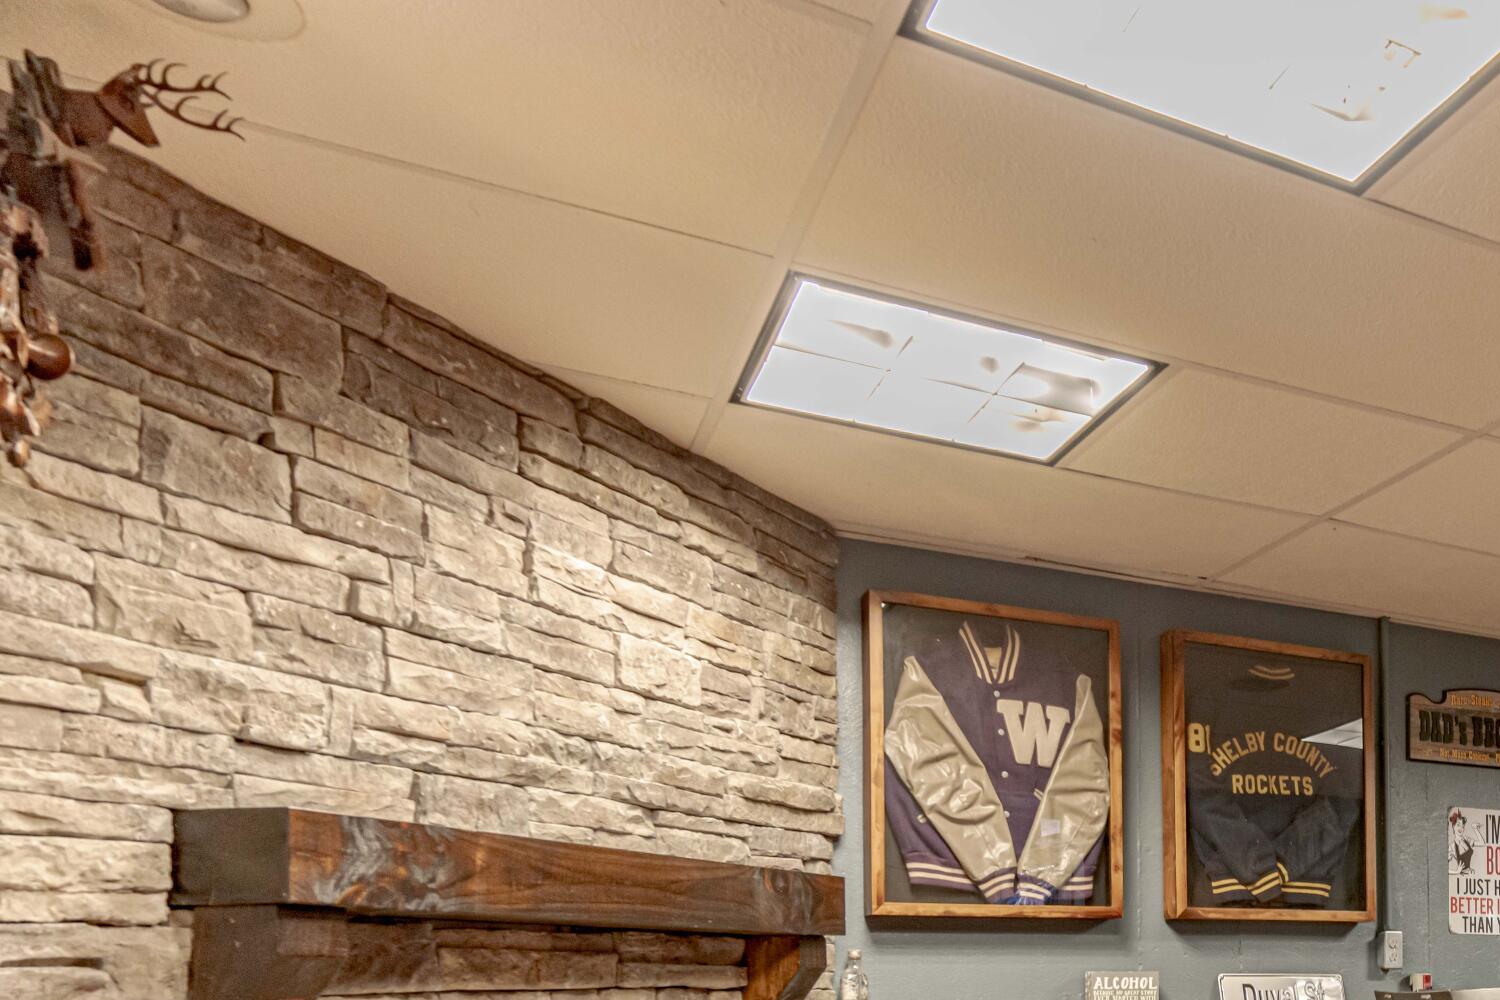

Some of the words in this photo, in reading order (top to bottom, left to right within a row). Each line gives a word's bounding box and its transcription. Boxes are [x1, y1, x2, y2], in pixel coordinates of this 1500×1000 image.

[997, 699, 1071, 768] W
[1210, 731, 1265, 776] SHELBY
[1273, 732, 1335, 778] COUNTY
[1231, 774, 1313, 796] ROCKETS
[1464, 878, 1491, 896] JUST
[1450, 896, 1494, 915] BETTER
[1462, 916, 1493, 934] THAN
[1093, 976, 1158, 990] ALCOHOL
